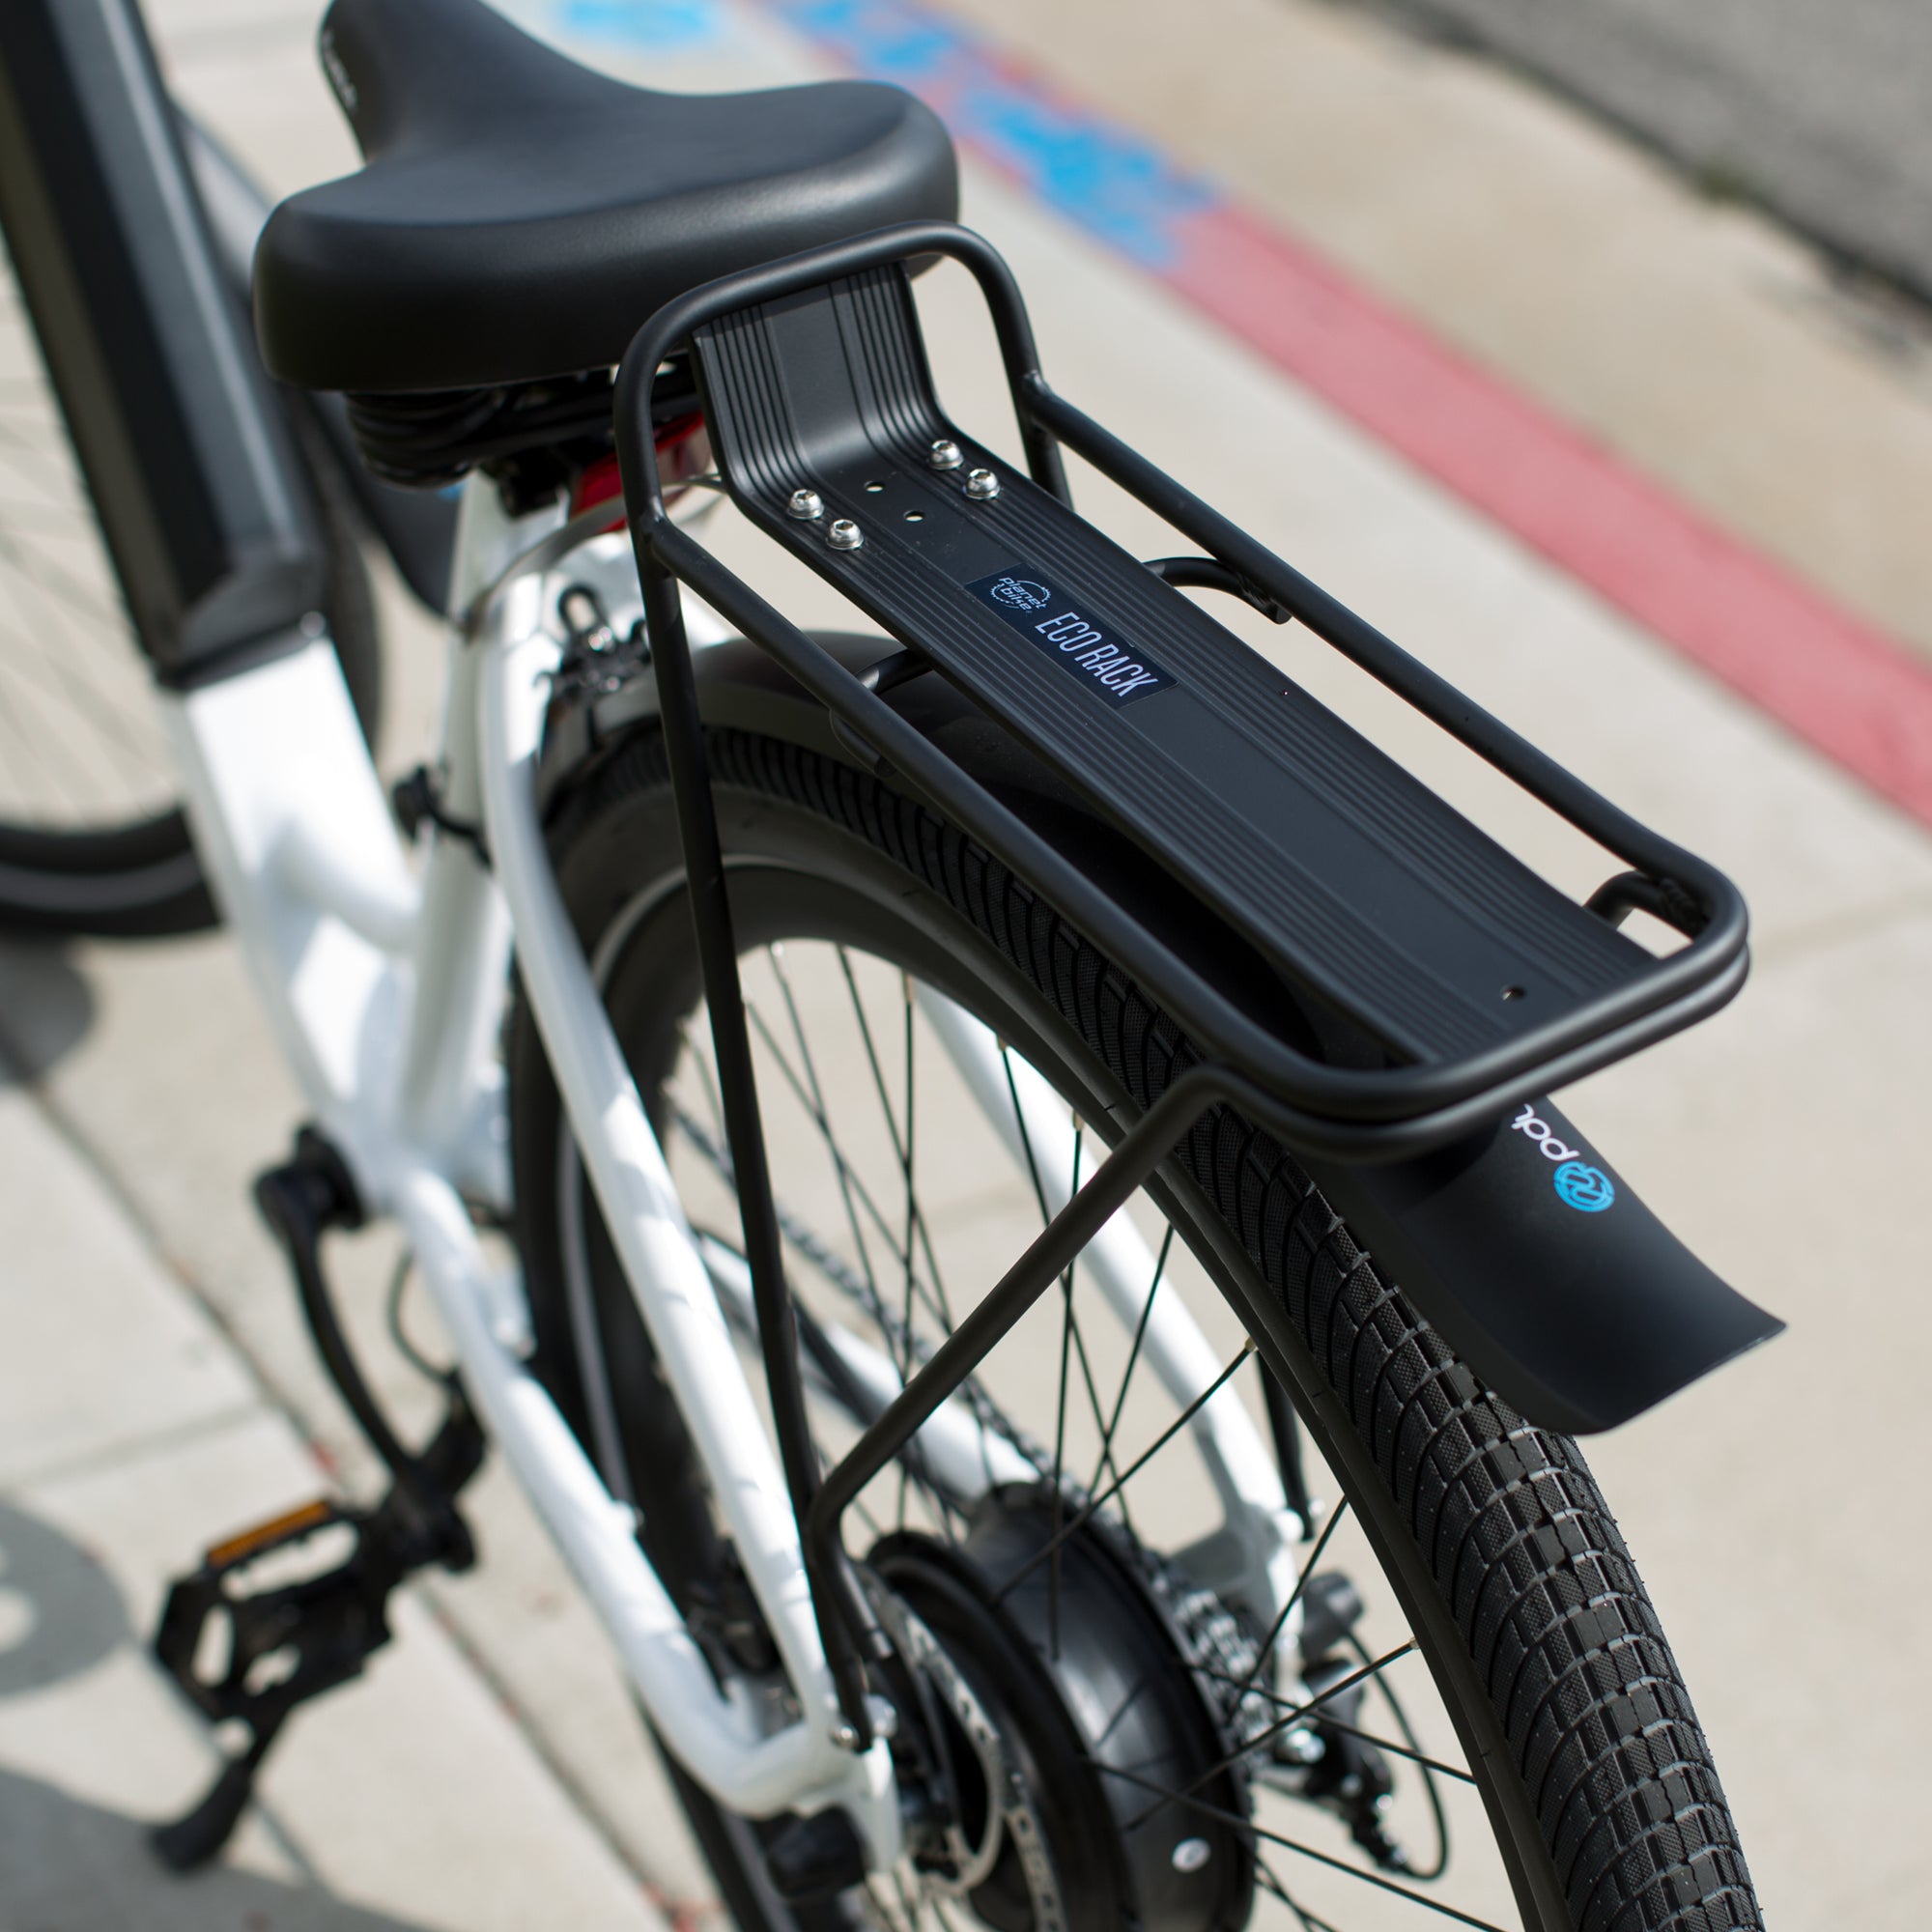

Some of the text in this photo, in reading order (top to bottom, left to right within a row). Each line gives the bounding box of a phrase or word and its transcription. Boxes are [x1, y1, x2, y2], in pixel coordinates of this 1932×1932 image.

[999, 577, 1047, 610] planet
[1035, 611, 1158, 697] ECO RACK
